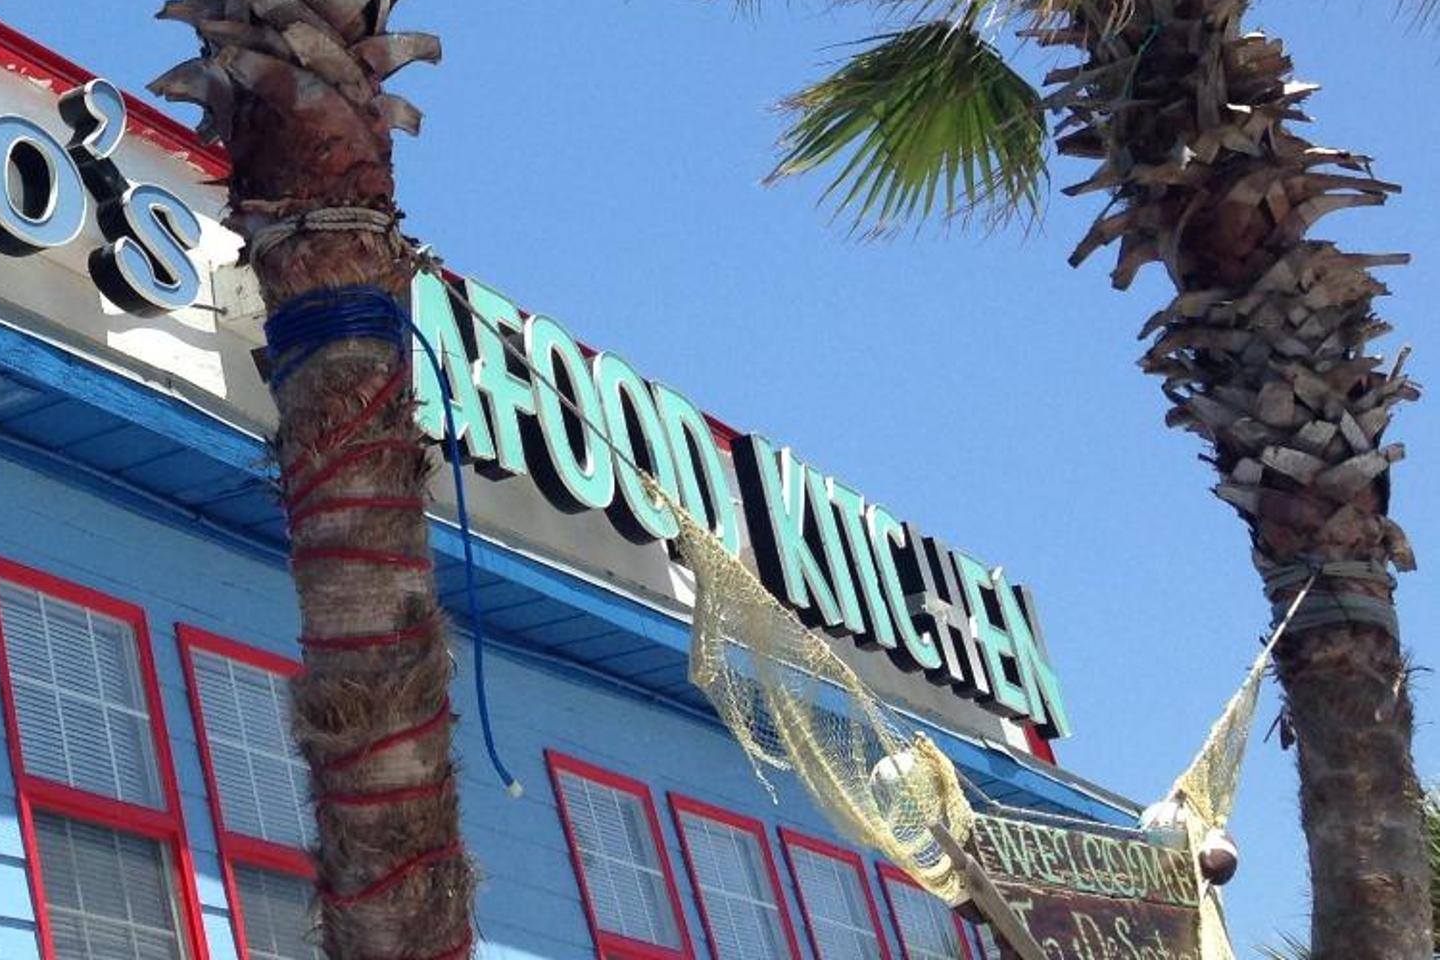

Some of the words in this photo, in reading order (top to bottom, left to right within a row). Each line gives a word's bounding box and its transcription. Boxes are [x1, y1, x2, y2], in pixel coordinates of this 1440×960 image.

[413, 268, 741, 562] AFOOD
[744, 432, 1072, 738] KITCHEN
[974, 813, 1201, 908] WELCOME
